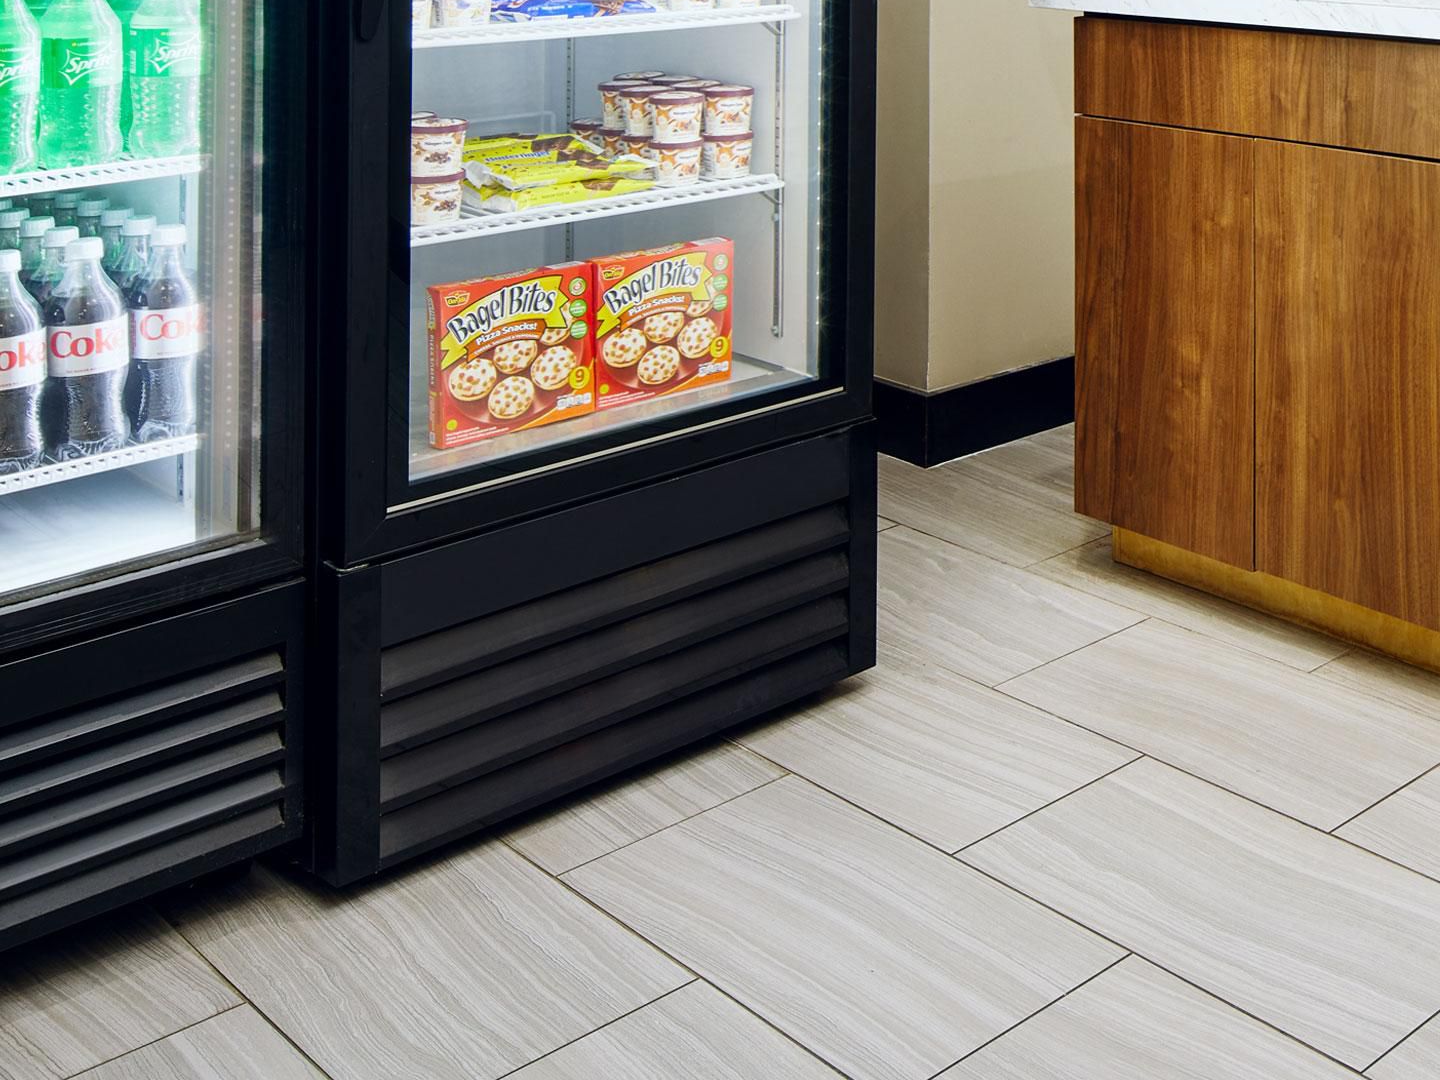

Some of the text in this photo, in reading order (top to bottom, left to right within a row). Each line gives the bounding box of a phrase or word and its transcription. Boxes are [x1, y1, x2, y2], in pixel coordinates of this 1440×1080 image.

[604, 258, 701, 314] Bagel Bites
[448, 281, 556, 344] Bagel Bites
[50, 327, 123, 359] Coke
[715, 338, 724, 352] 9
[574, 369, 585, 383] 9
